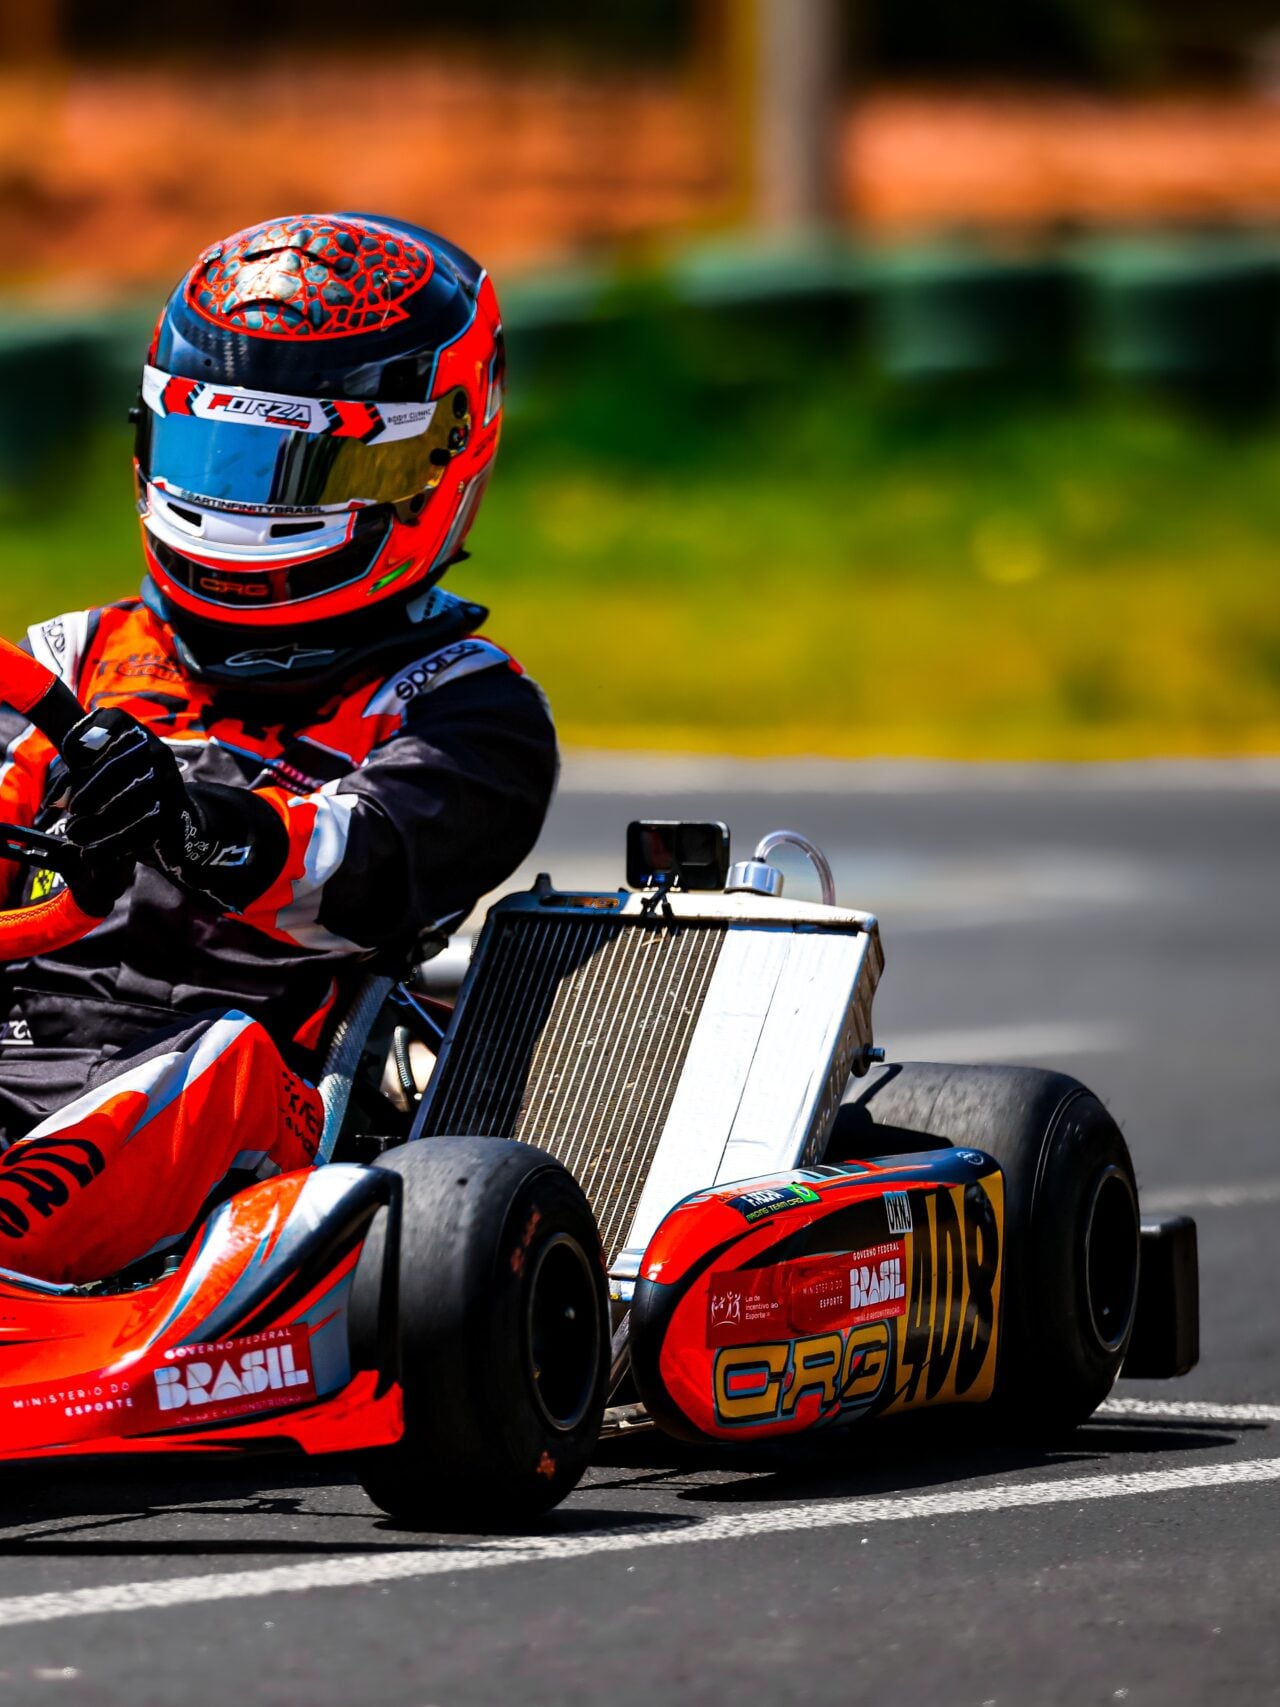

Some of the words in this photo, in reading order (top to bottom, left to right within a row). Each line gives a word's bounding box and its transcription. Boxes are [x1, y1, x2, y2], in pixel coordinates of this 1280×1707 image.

[208, 393, 312, 423] FORZA
[200, 577, 269, 597] CRG
[395, 641, 480, 700] sparco
[852, 1247, 877, 1261] GOVERNO
[877, 1241, 900, 1255] FEDERAL
[849, 1257, 906, 1310] BRASIL
[899, 1183, 1000, 1404] 408
[819, 1295, 844, 1308] ESPORTE
[163, 1341, 234, 1360] GOVERNO
[239, 1328, 292, 1345] FEDERAL
[110, 1381, 130, 1393] DO
[154, 1344, 309, 1411] BRASIL
[713, 1319, 891, 1424] CRG
[64, 1397, 134, 1417] ESPORTE
